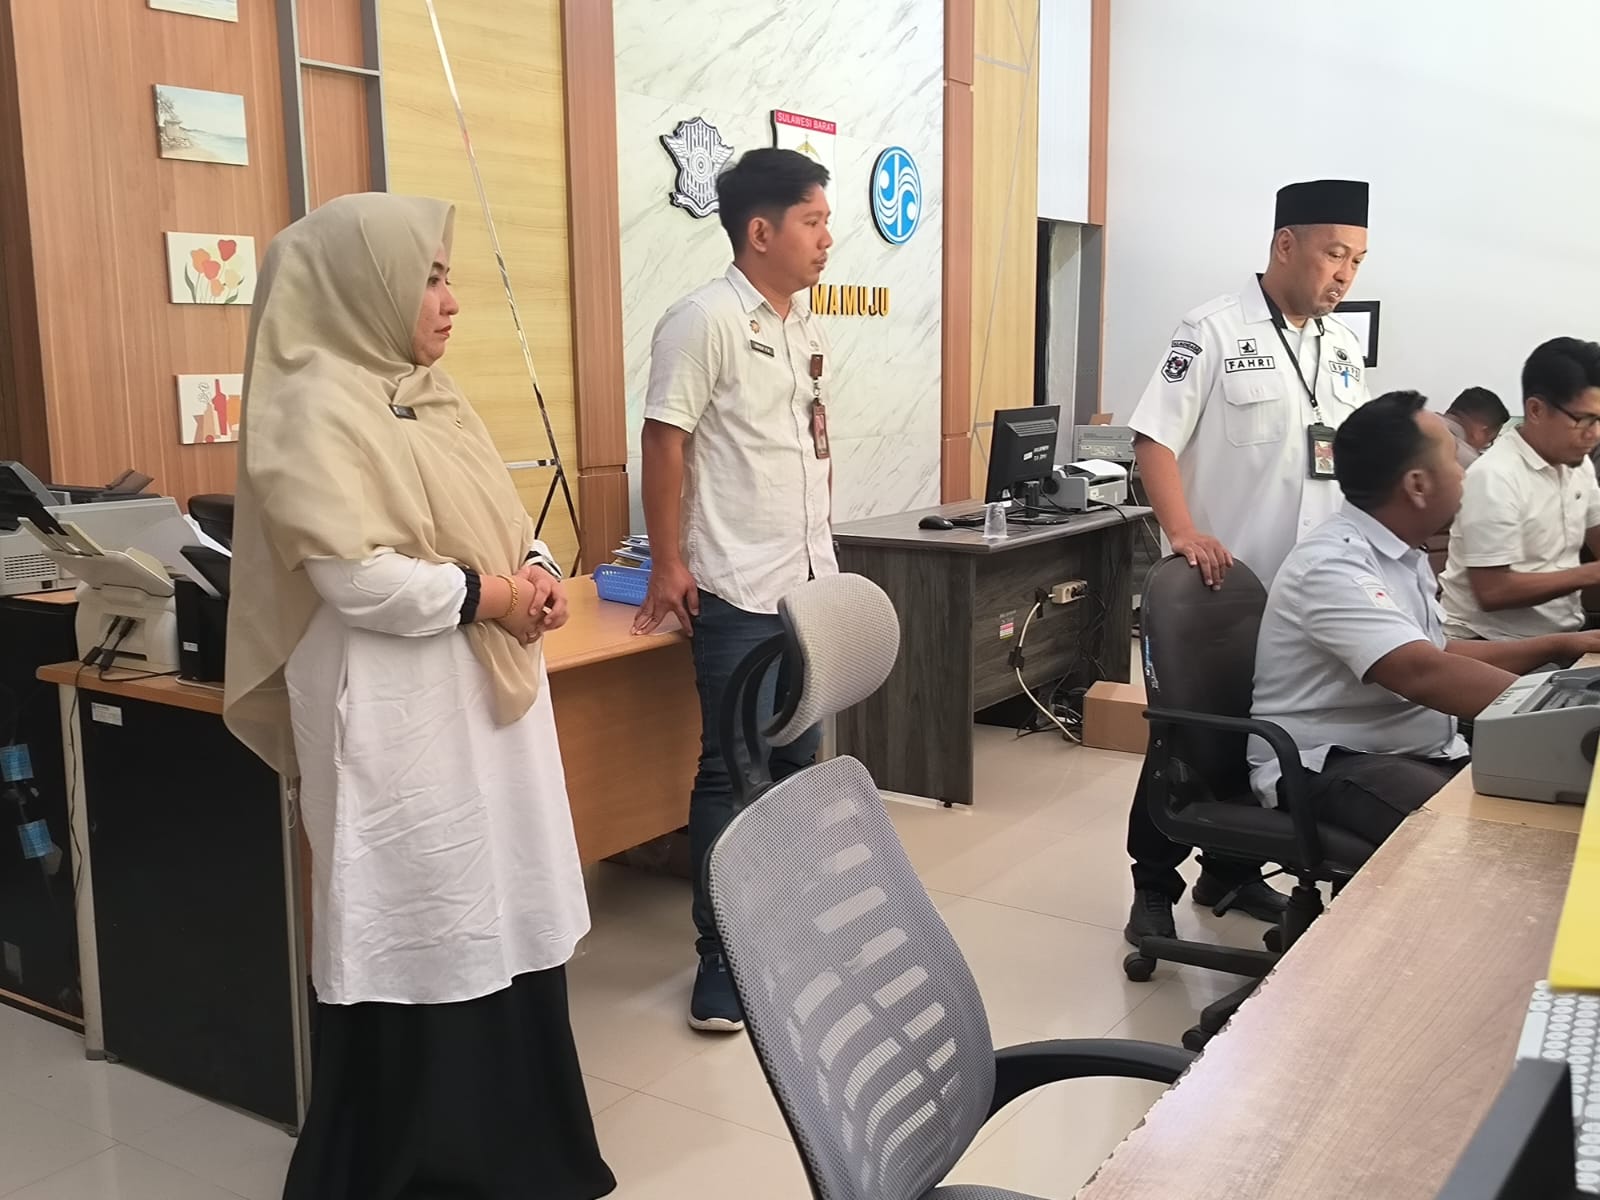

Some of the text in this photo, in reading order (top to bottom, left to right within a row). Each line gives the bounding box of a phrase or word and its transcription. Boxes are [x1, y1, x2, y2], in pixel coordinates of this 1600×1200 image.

[777, 112, 834, 131] SULAWESI BARAT
[810, 284, 889, 316] MAMUJU
[1228, 358, 1271, 370] FAHRI
